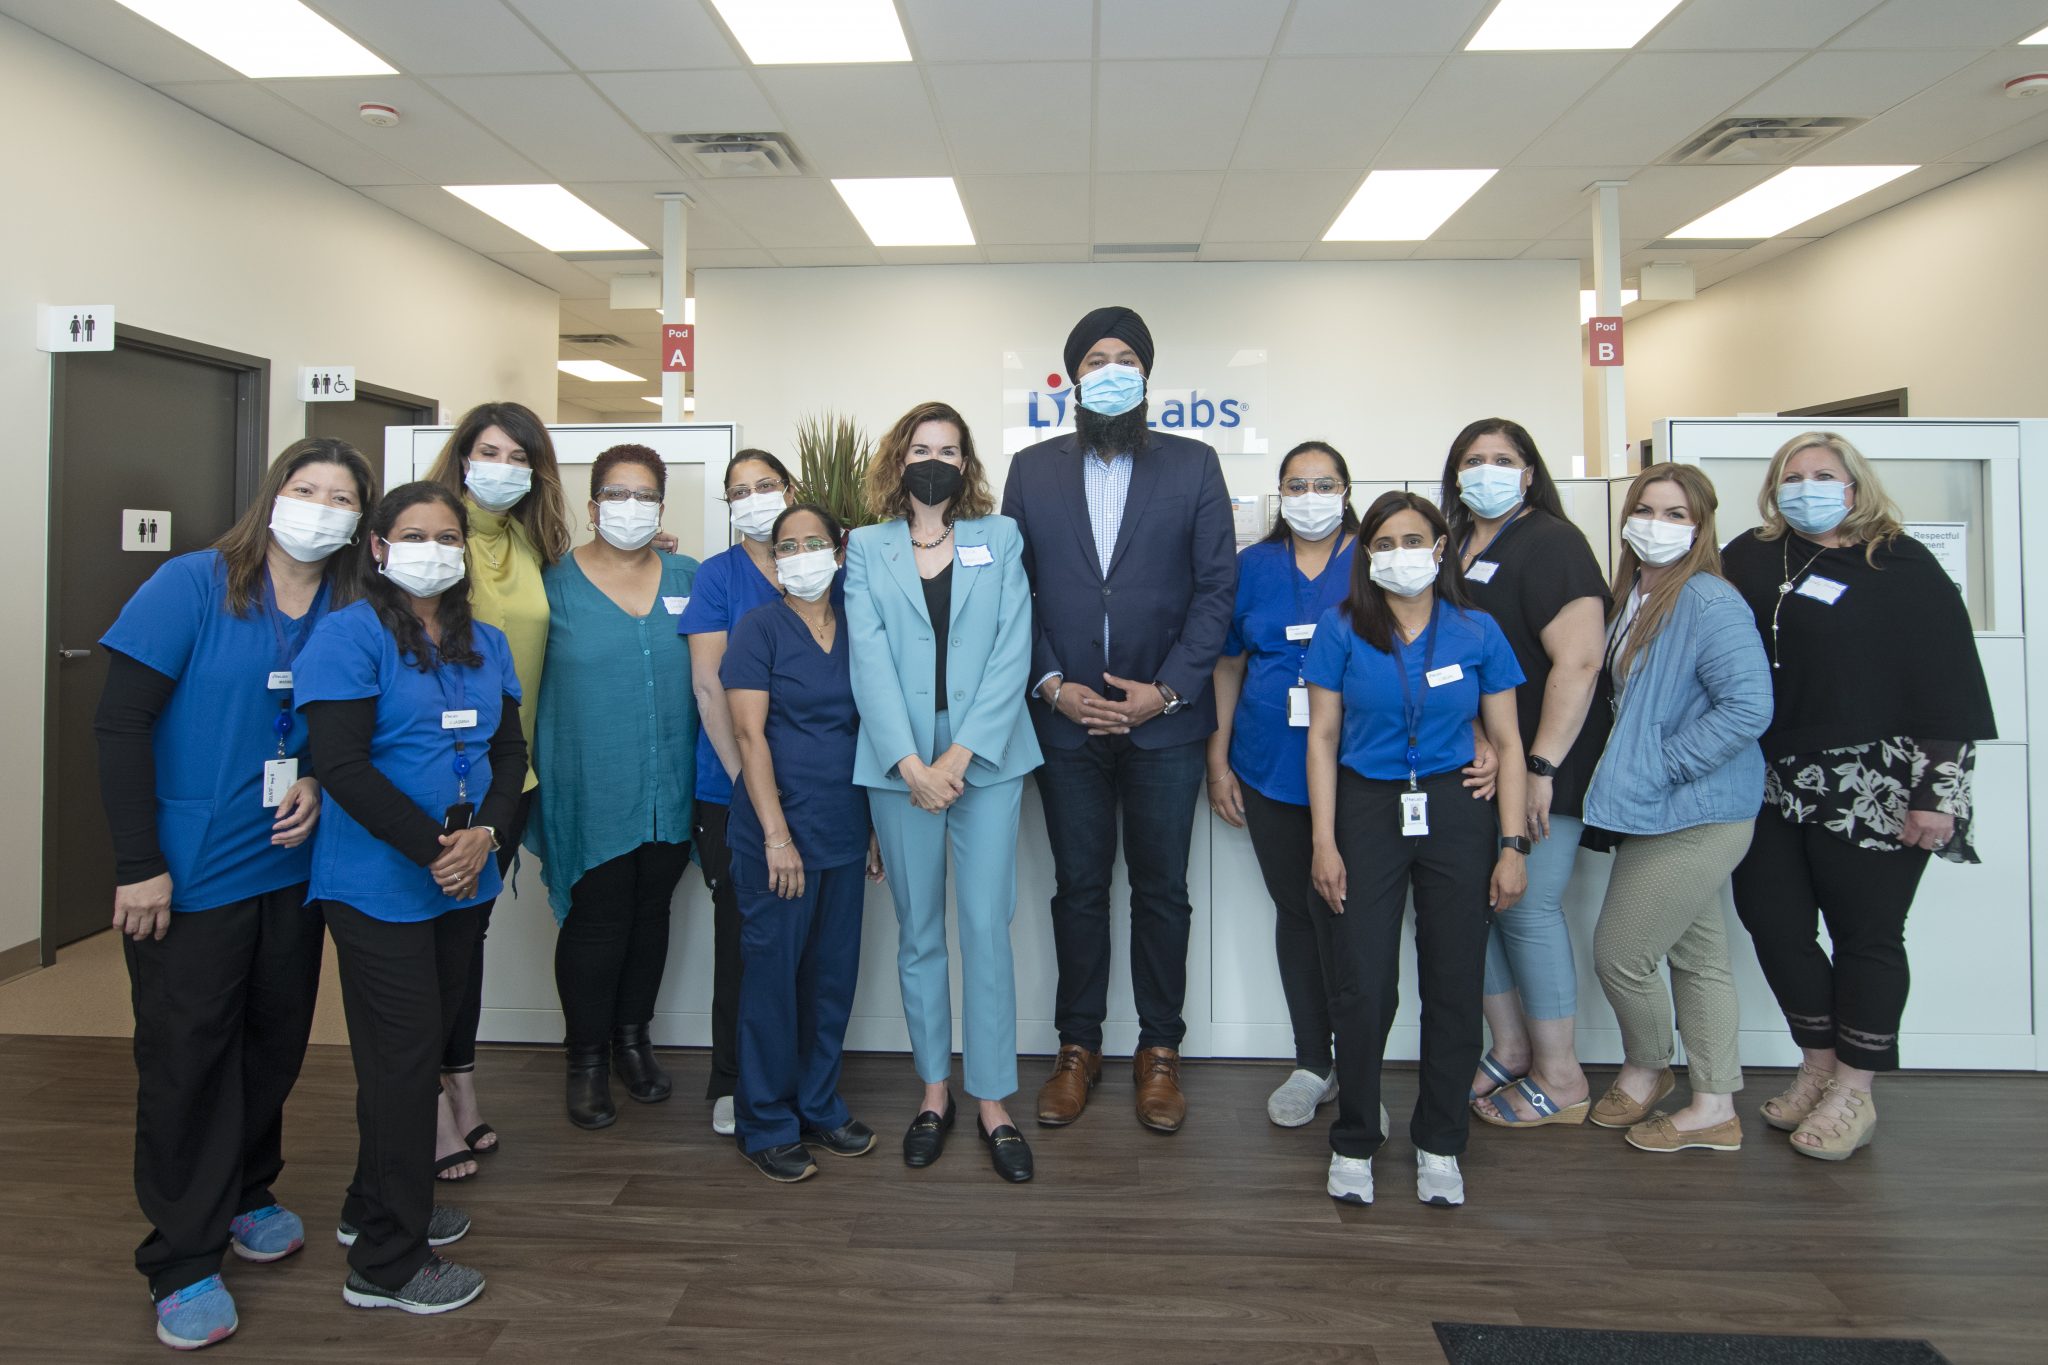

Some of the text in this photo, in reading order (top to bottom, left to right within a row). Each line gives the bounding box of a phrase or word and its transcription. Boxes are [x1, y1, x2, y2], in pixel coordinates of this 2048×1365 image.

[1595, 322, 1617, 331] Pod
[668, 329, 688, 338] Pod
[1598, 342, 1615, 361] B
[669, 348, 687, 367] A
[1913, 531, 1960, 540] Respectful
